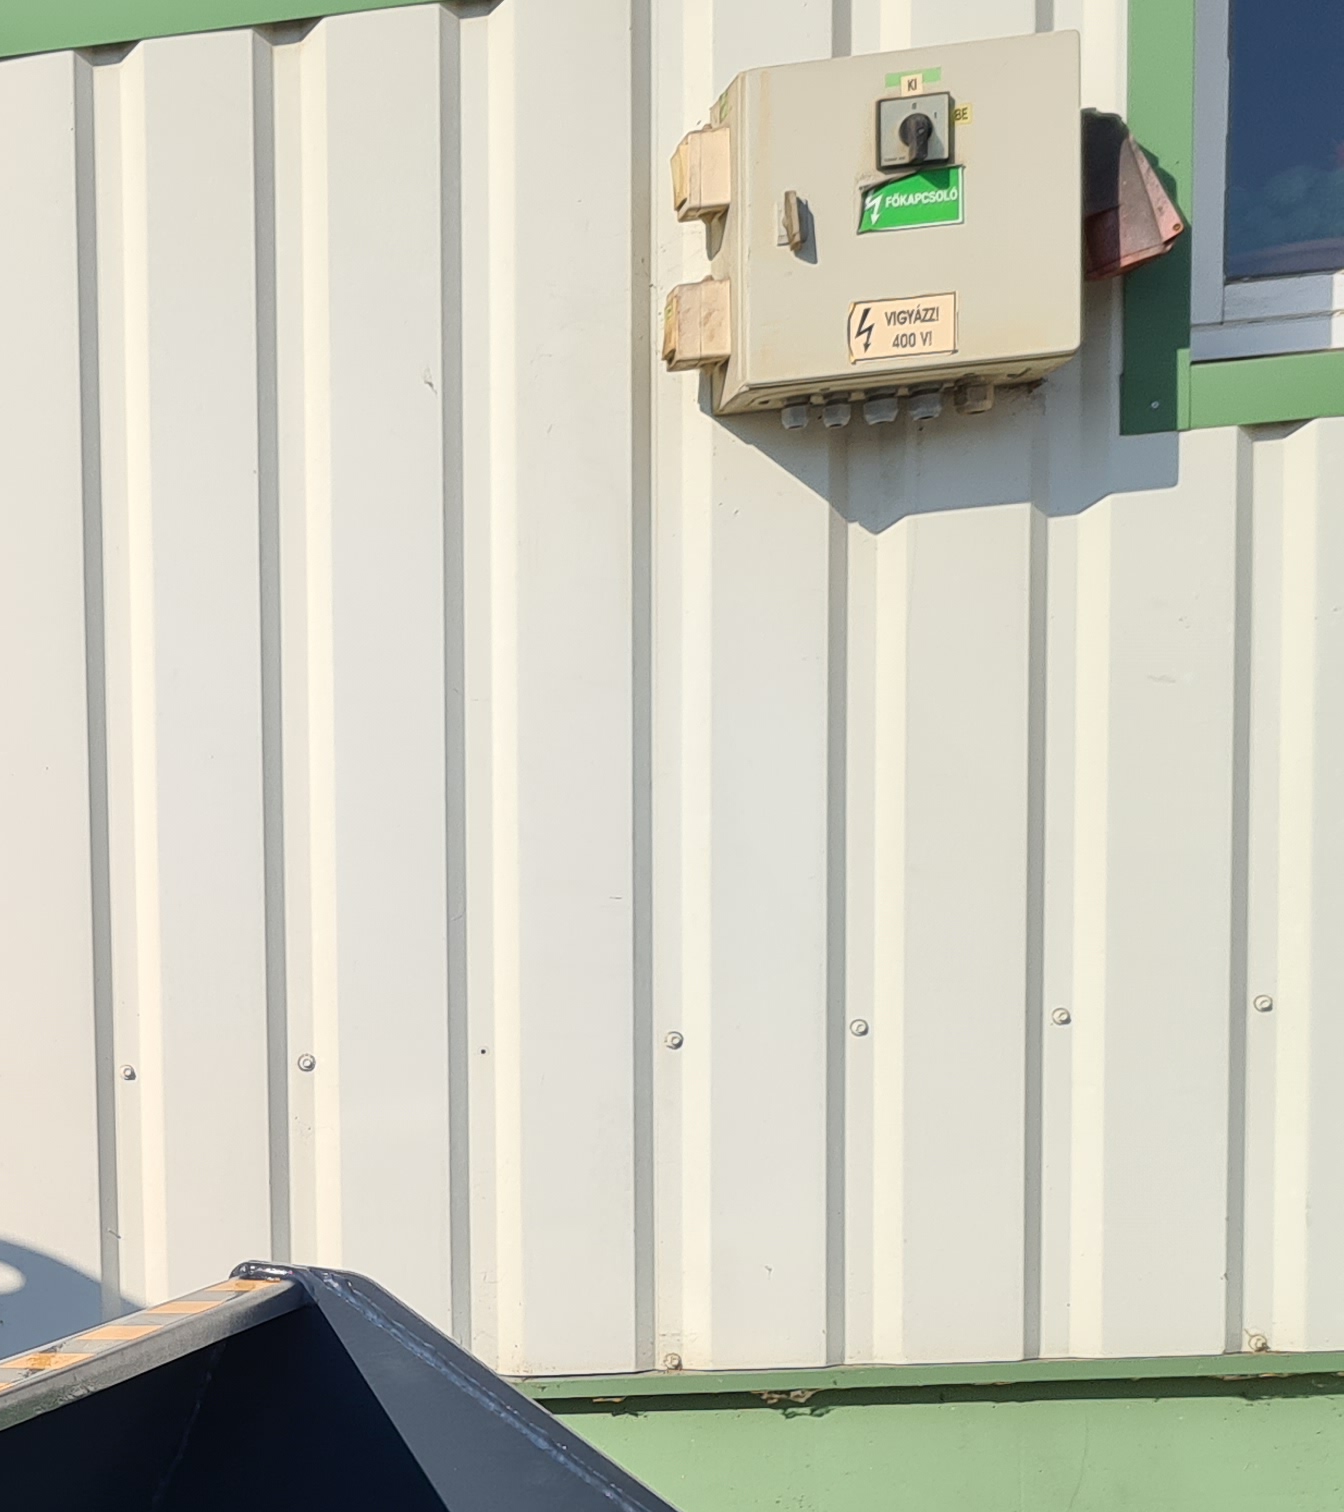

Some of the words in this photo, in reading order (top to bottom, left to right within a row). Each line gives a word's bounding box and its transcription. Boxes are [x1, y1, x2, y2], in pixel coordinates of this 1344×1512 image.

[907, 78, 917, 91] KI
[953, 107, 968, 120] BE
[885, 188, 958, 209] FŐKAPCSOLÓ
[885, 304, 940, 327] VIGYÁZZ!
[892, 332, 916, 349] 400
[920, 331, 933, 347] V!
